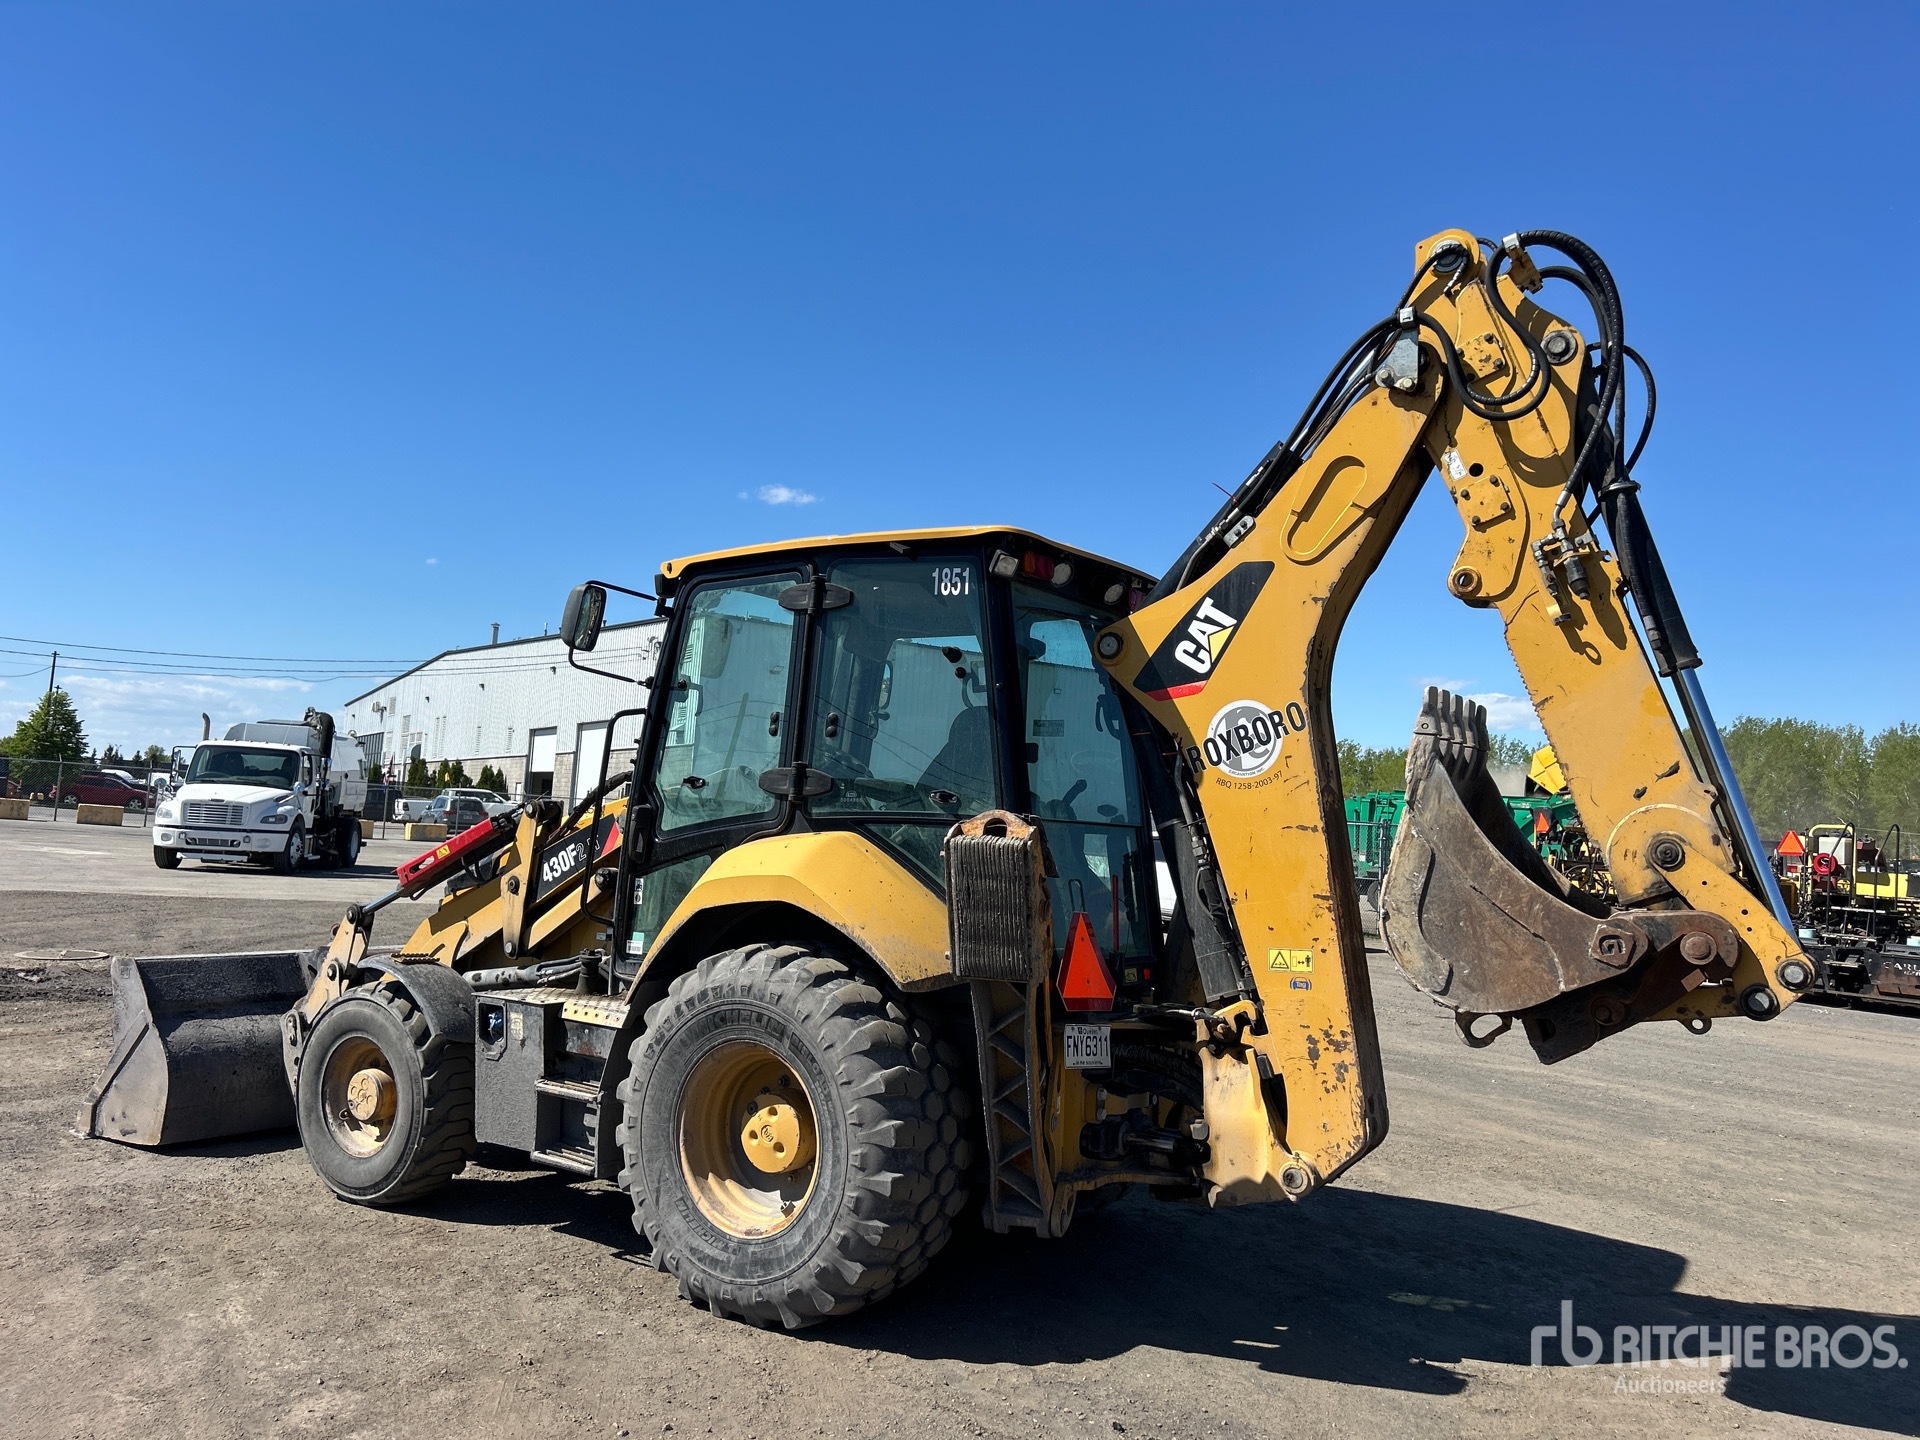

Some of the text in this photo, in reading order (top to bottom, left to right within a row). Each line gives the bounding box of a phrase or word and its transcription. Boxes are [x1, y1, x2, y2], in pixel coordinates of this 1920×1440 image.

[932, 567, 970, 596] 1851
[1174, 596, 1238, 674] CAT
[1186, 701, 1308, 775] ROXBORO
[1215, 769, 1283, 790] RBQ 1258-2003-97
[1066, 1035, 1109, 1057] FNY6311
